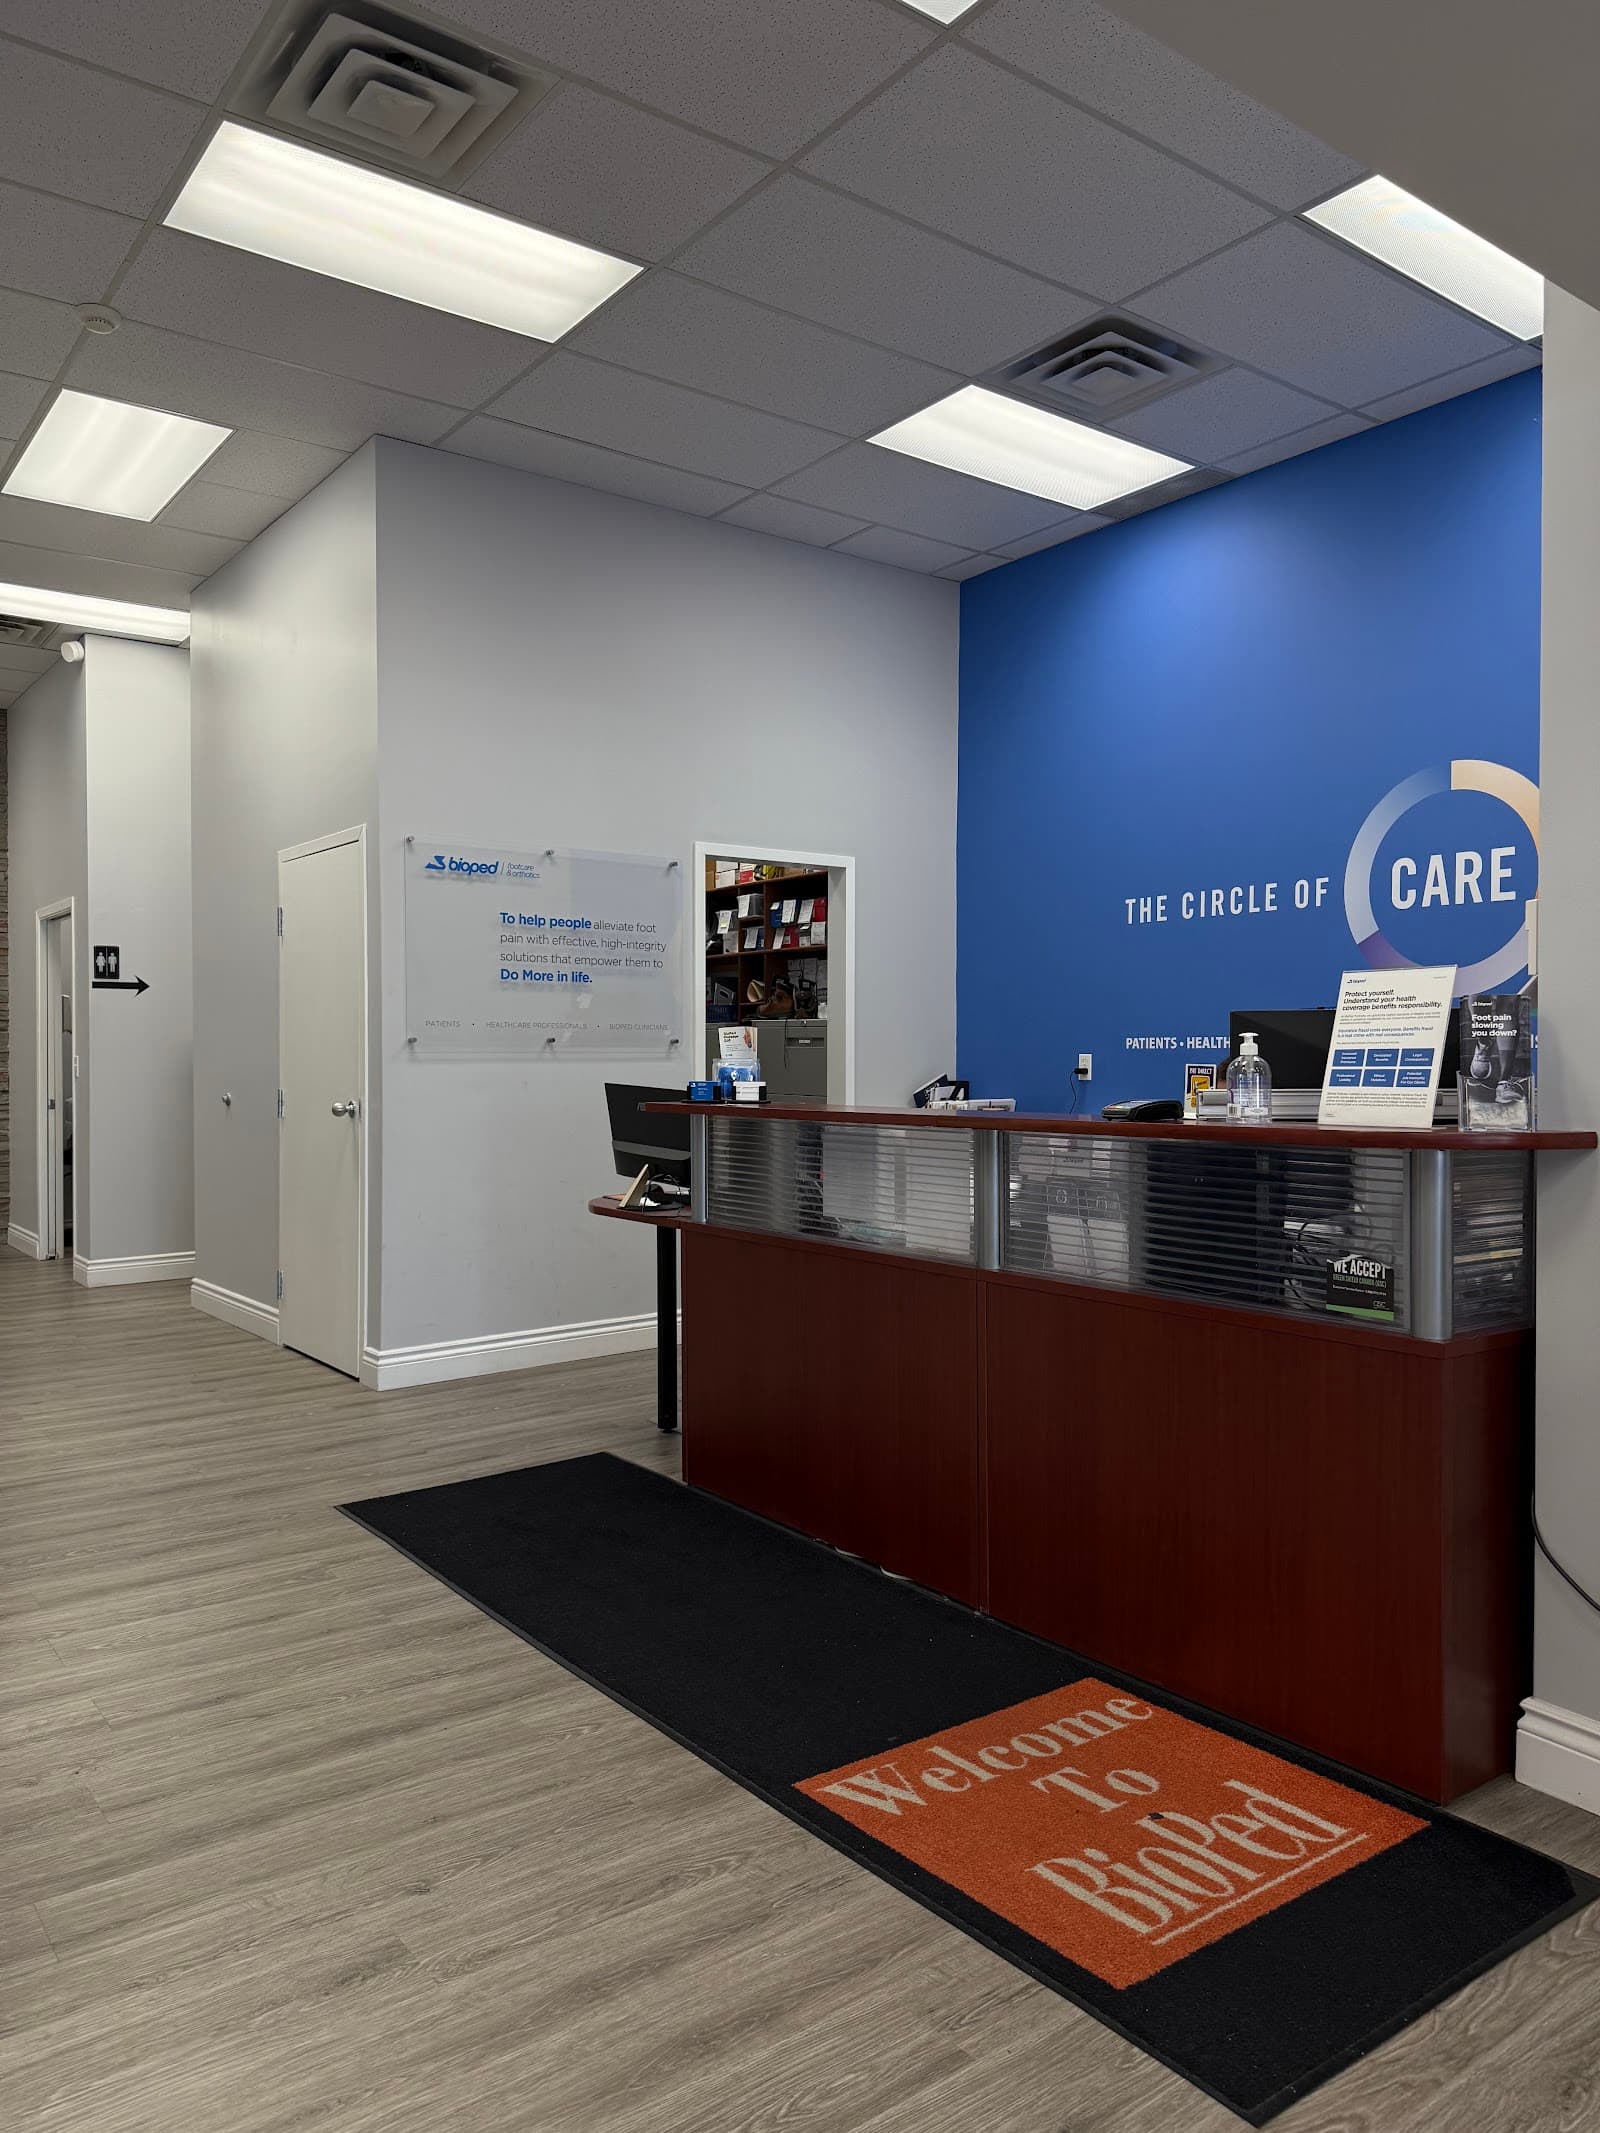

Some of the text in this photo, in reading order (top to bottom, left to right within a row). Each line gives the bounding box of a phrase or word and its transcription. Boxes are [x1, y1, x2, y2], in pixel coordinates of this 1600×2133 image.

[449, 857, 499, 875] bioped
[508, 862, 534, 871] footcare
[513, 871, 541, 879] orthotics
[1126, 846, 1516, 924] THE CIRCLE OF CARE
[500, 912, 656, 934] To help people alleviate foot
[500, 934, 667, 952] pain with effective, high-integrity
[500, 952, 663, 970] solutions that empower them to
[500, 968, 592, 984] Do More in life.
[1372, 1002, 1396, 1010] benefits
[1398, 1001, 1442, 1009] responsibility.
[425, 1020, 460, 1028] PATIENTS
[1126, 1036, 1230, 1049] PATIENTS HEALTH
[1333, 1260, 1386, 1279] WE ACCEPT
[817, 1698, 1155, 1818] Welcome
[1031, 1766, 1162, 1815] To
[1025, 1779, 1355, 1937] BioPed
